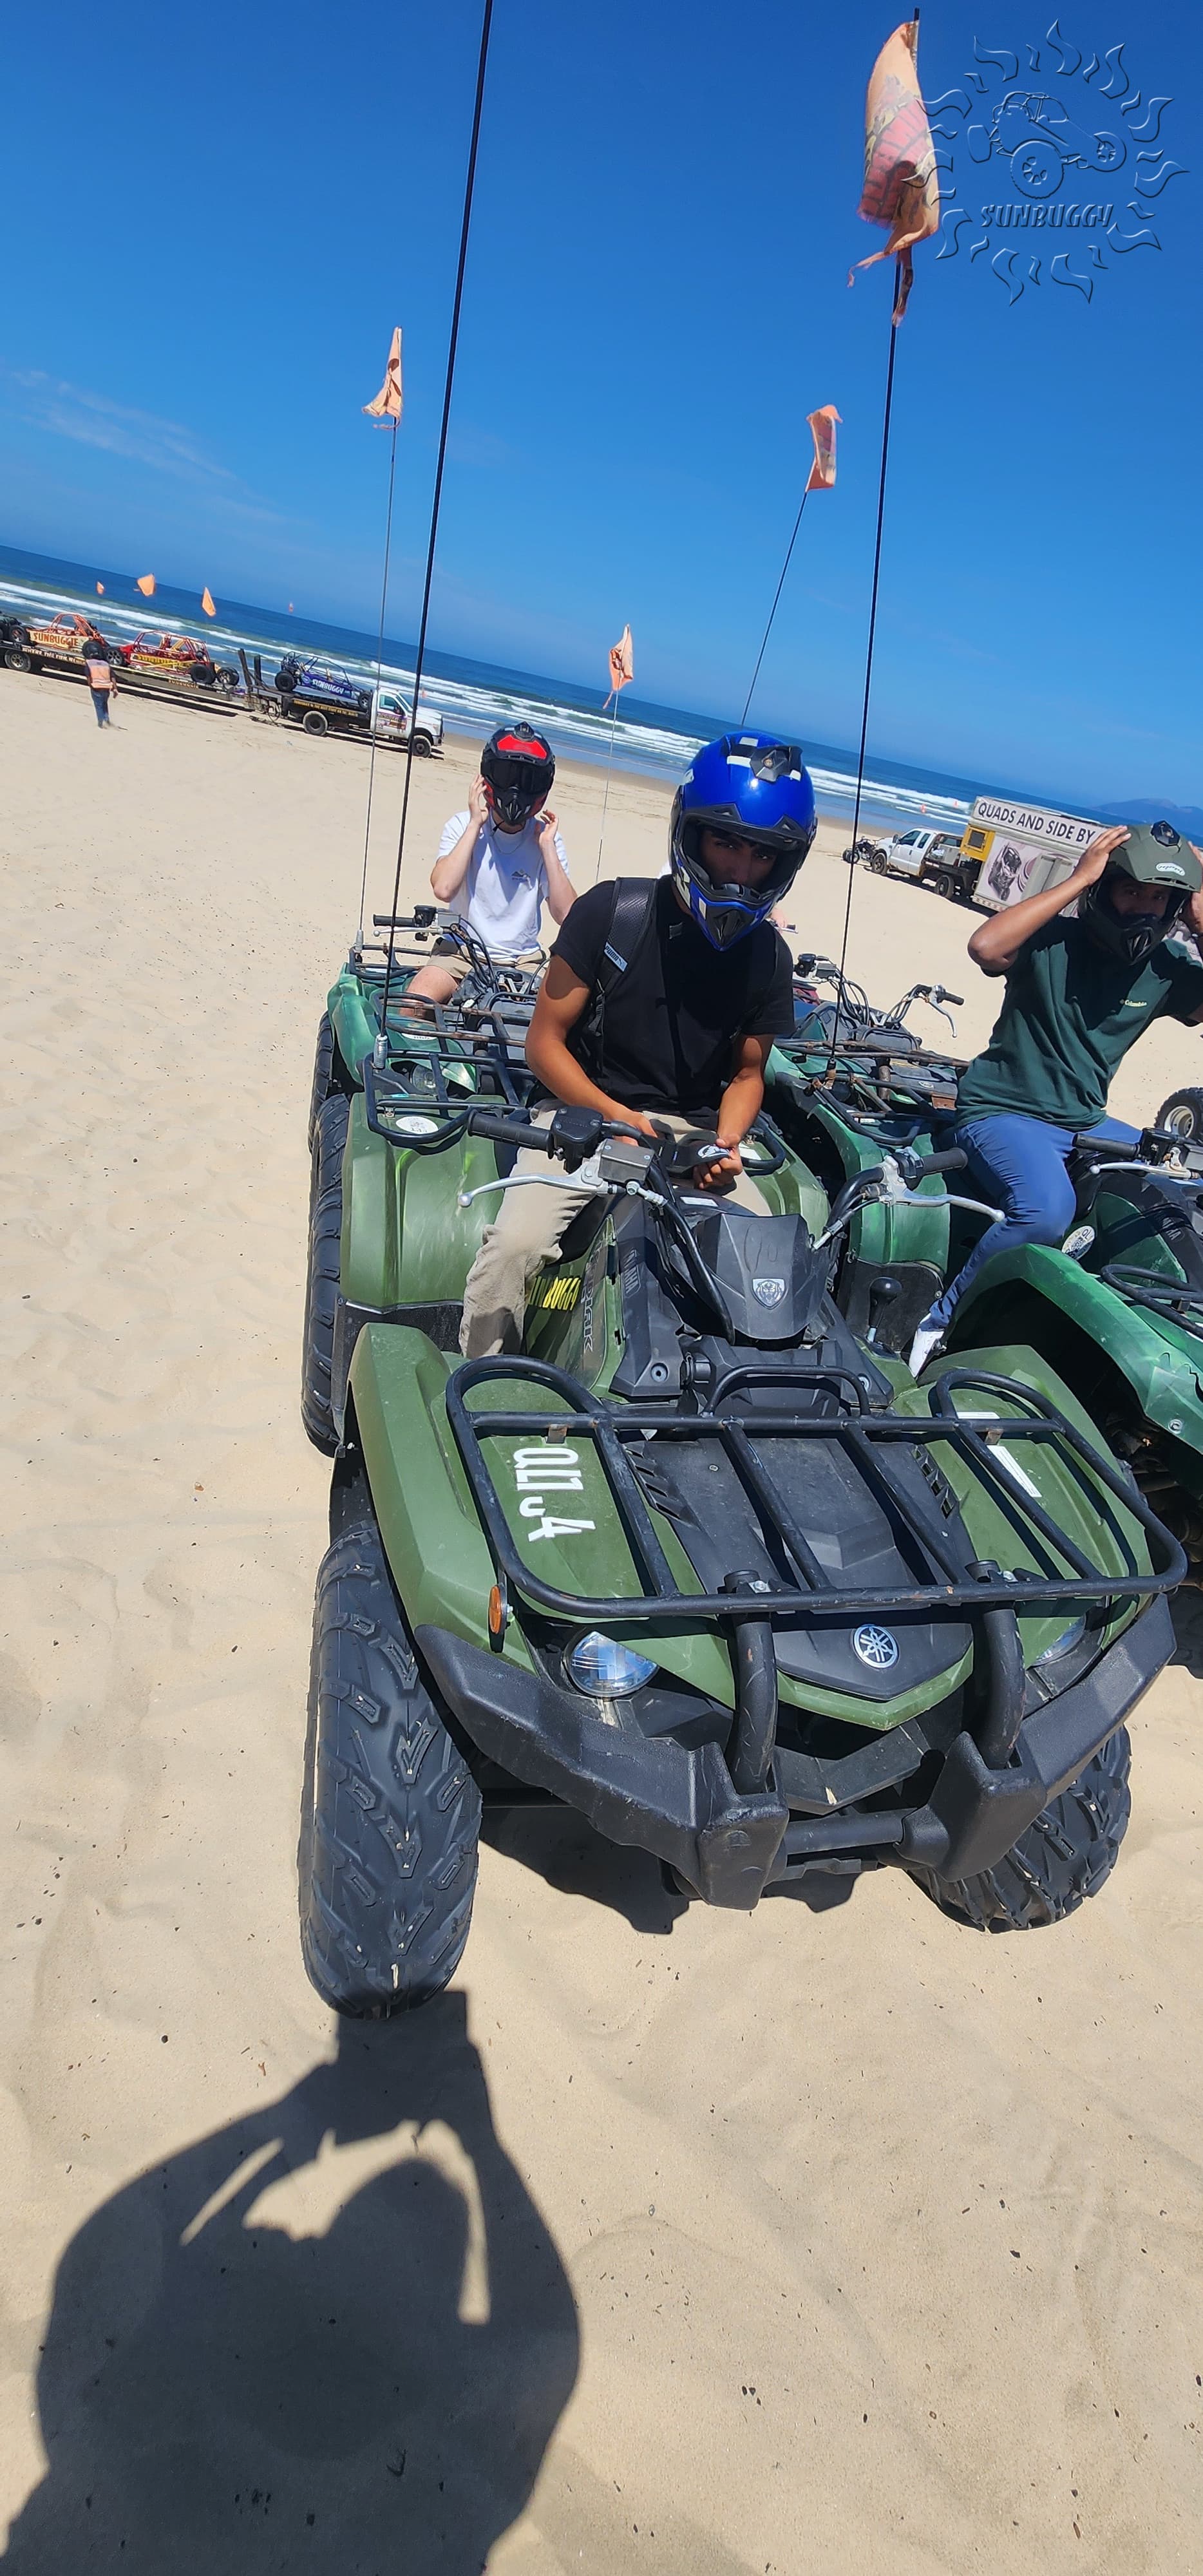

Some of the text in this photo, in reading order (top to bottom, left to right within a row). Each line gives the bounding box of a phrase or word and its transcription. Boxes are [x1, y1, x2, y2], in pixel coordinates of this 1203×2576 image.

[312, 679, 345, 694] SUNBUGGY
[978, 802, 1095, 844] QUADS AND SIDE BY
[605, 945, 619, 961] PUMA
[527, 1276, 582, 1311] UNBUGGY
